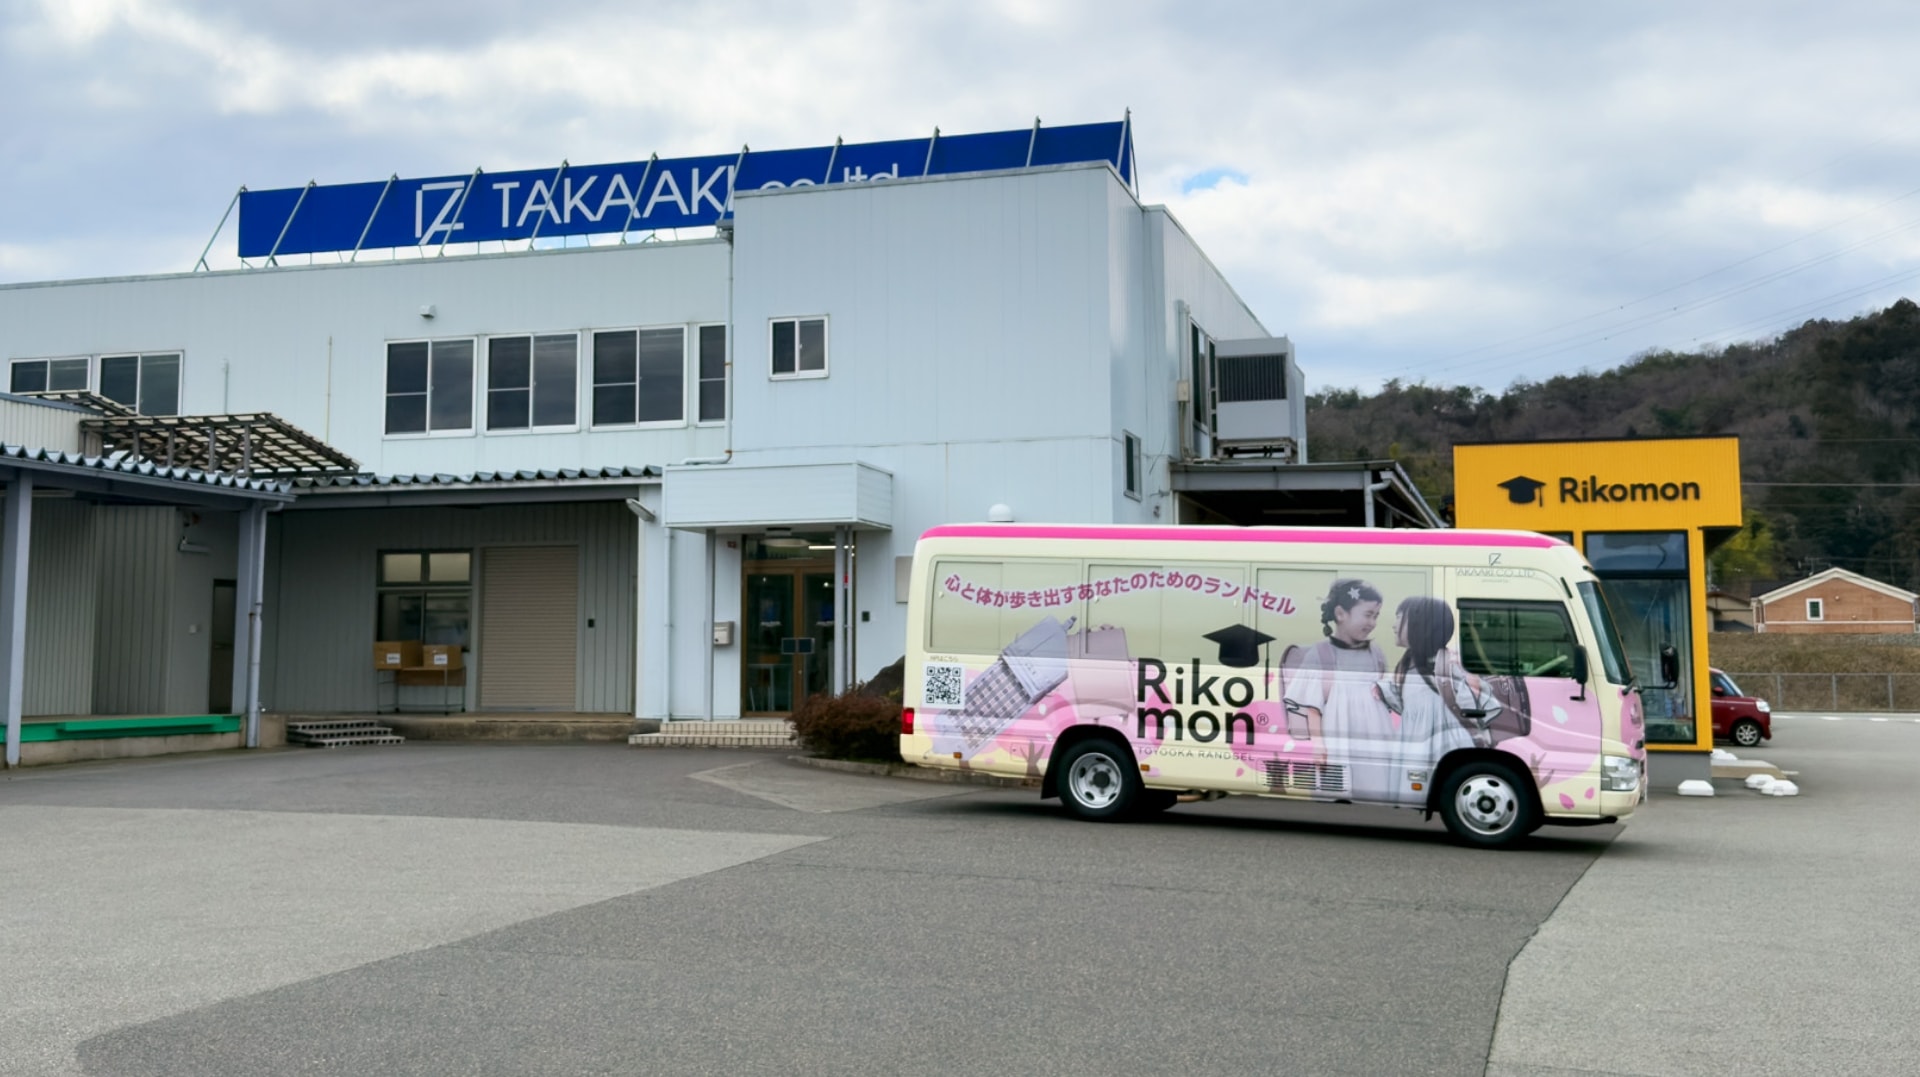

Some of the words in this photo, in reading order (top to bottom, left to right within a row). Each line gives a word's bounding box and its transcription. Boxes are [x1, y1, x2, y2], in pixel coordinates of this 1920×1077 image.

[492, 164, 735, 228] TAKAAKI
[1559, 475, 1700, 504] Rikomon
[944, 570, 1296, 616] 心と体が歩き出すあなたのためのランドセル
[1137, 657, 1255, 709] Riko
[1137, 746, 1194, 759] TOYOOKA
[1197, 750, 1256, 762] RANDSEL
